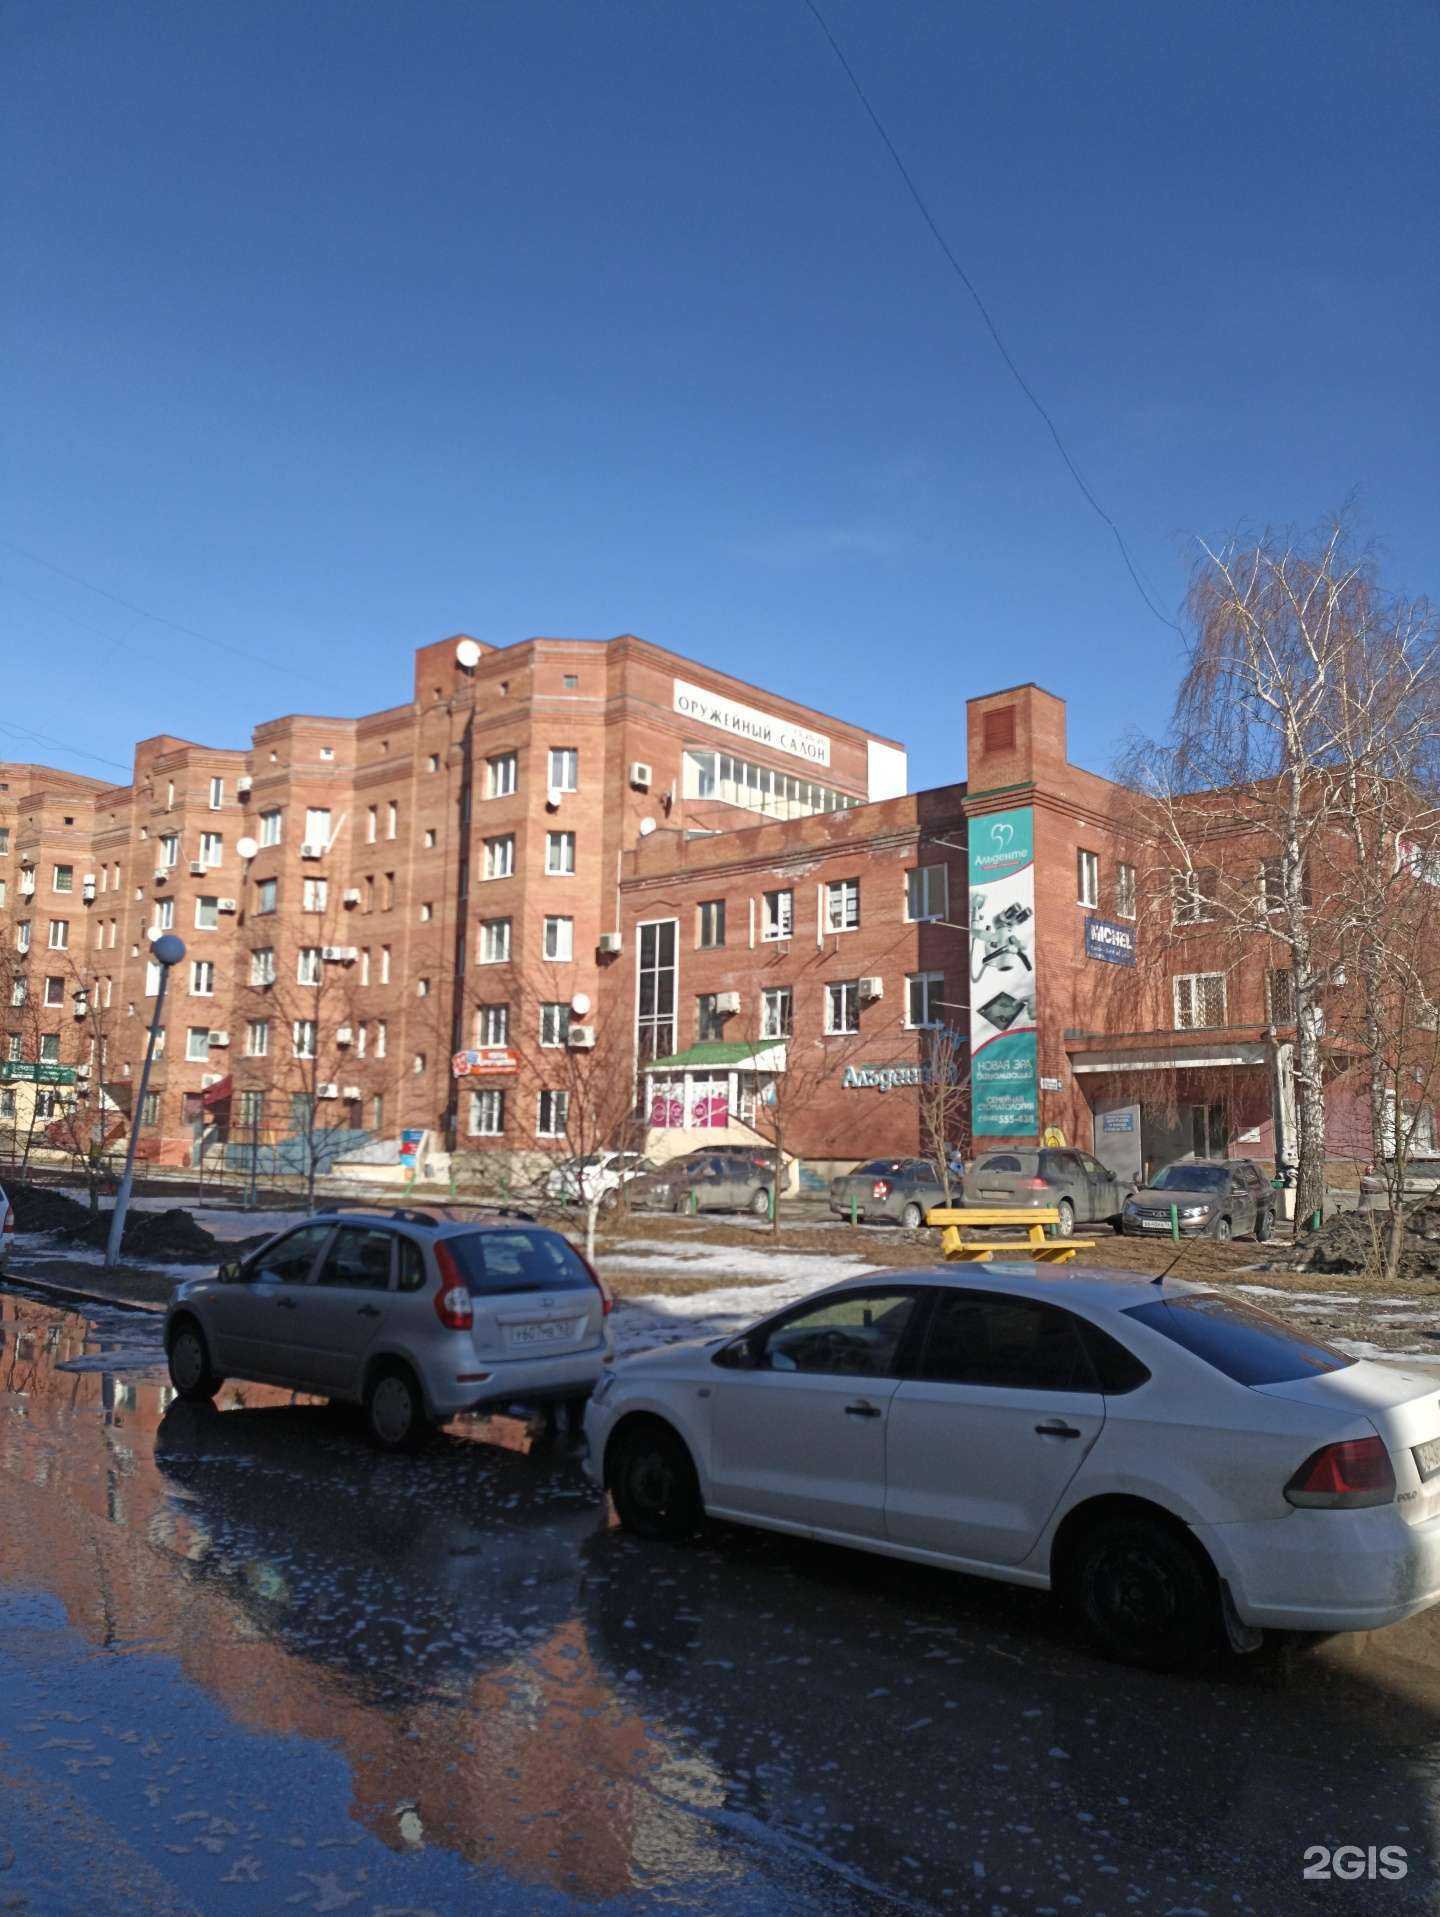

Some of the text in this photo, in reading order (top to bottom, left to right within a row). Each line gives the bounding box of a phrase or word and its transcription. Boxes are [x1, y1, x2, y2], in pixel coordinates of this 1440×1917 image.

[678, 695, 771, 741] ОРУЖЕЙНЫЙ
[780, 733, 825, 761] САЛОН
[977, 1059, 1033, 1072] НОВАЯ ЭРА
[1396, 1490, 1418, 1503] POLO
